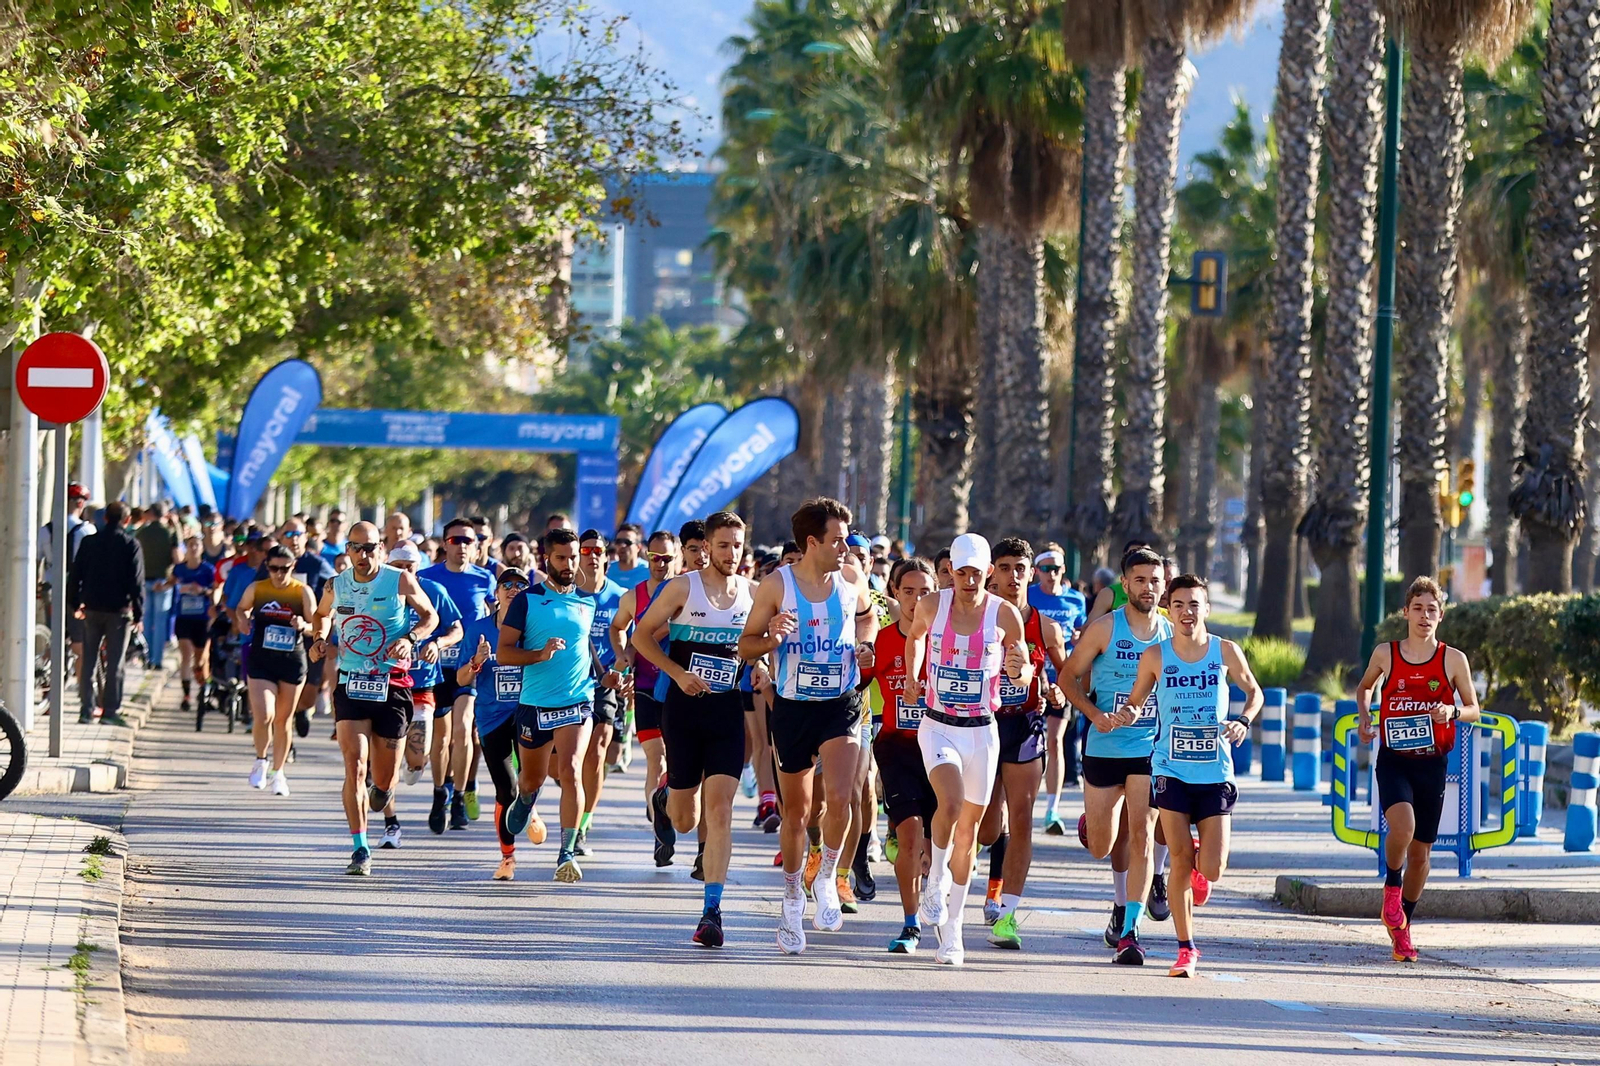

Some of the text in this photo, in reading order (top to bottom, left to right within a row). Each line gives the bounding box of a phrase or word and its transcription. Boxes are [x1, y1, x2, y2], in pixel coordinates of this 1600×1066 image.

[239, 385, 302, 487] mayoral
[518, 421, 605, 443] mayoral
[679, 422, 777, 507] mayoral
[444, 649, 461, 657] 18
[695, 668, 730, 682] 1992
[811, 676, 829, 687] 26
[1165, 670, 1219, 690] nerja
[352, 681, 383, 691] 1669
[950, 681, 968, 692] 25
[1174, 691, 1213, 699] ATLETISMO
[543, 708, 575, 721] 1955
[1391, 727, 1427, 740] 2149
[1176, 739, 1214, 750] 2156
